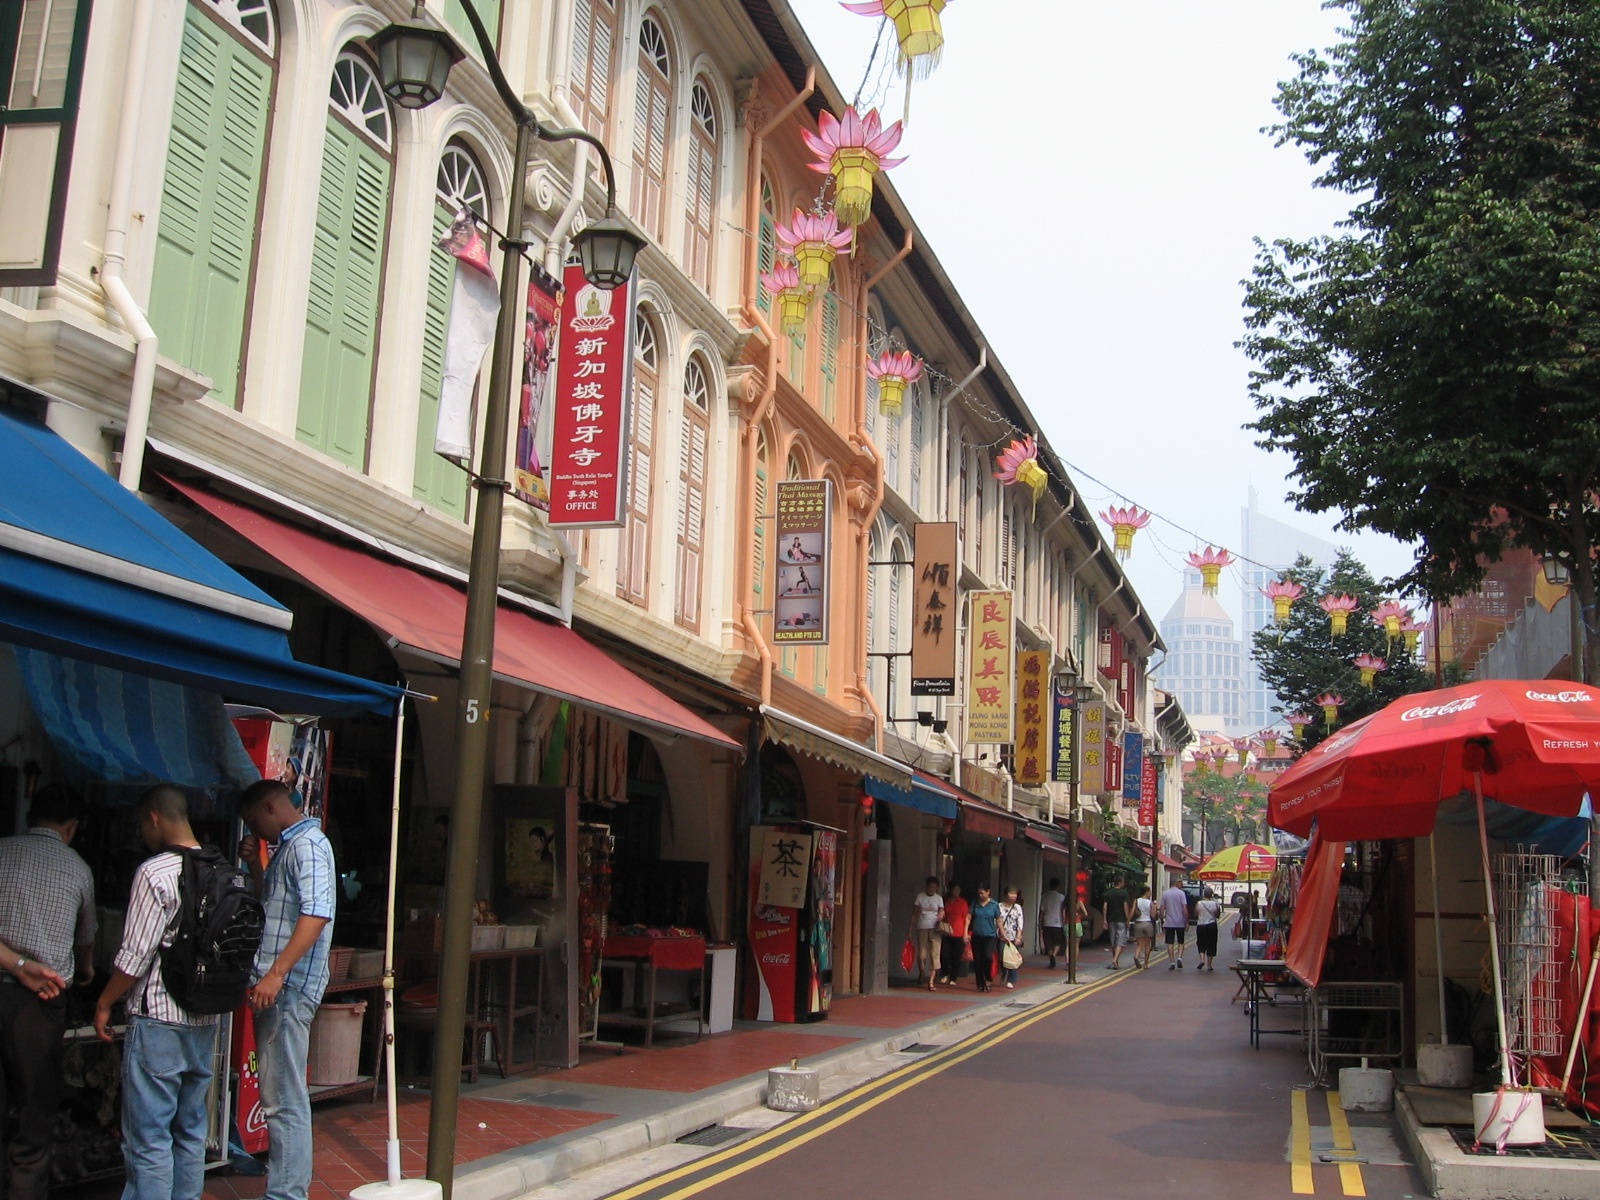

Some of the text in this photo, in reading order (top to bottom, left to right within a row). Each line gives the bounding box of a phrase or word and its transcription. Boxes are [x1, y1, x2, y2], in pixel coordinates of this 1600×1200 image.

[568, 337, 608, 467] 新加坡佛牙寺
[780, 484, 821, 492] Traditional
[565, 502, 597, 510] OFFICE
[466, 700, 478, 723] 5
[1058, 708, 1072, 761] 唐城餐室
[1544, 740, 1588, 748] REFRESH
[1307, 787, 1321, 798] YOUR
[1324, 776, 1342, 790] THIRST
[770, 838, 804, 878] 茶
